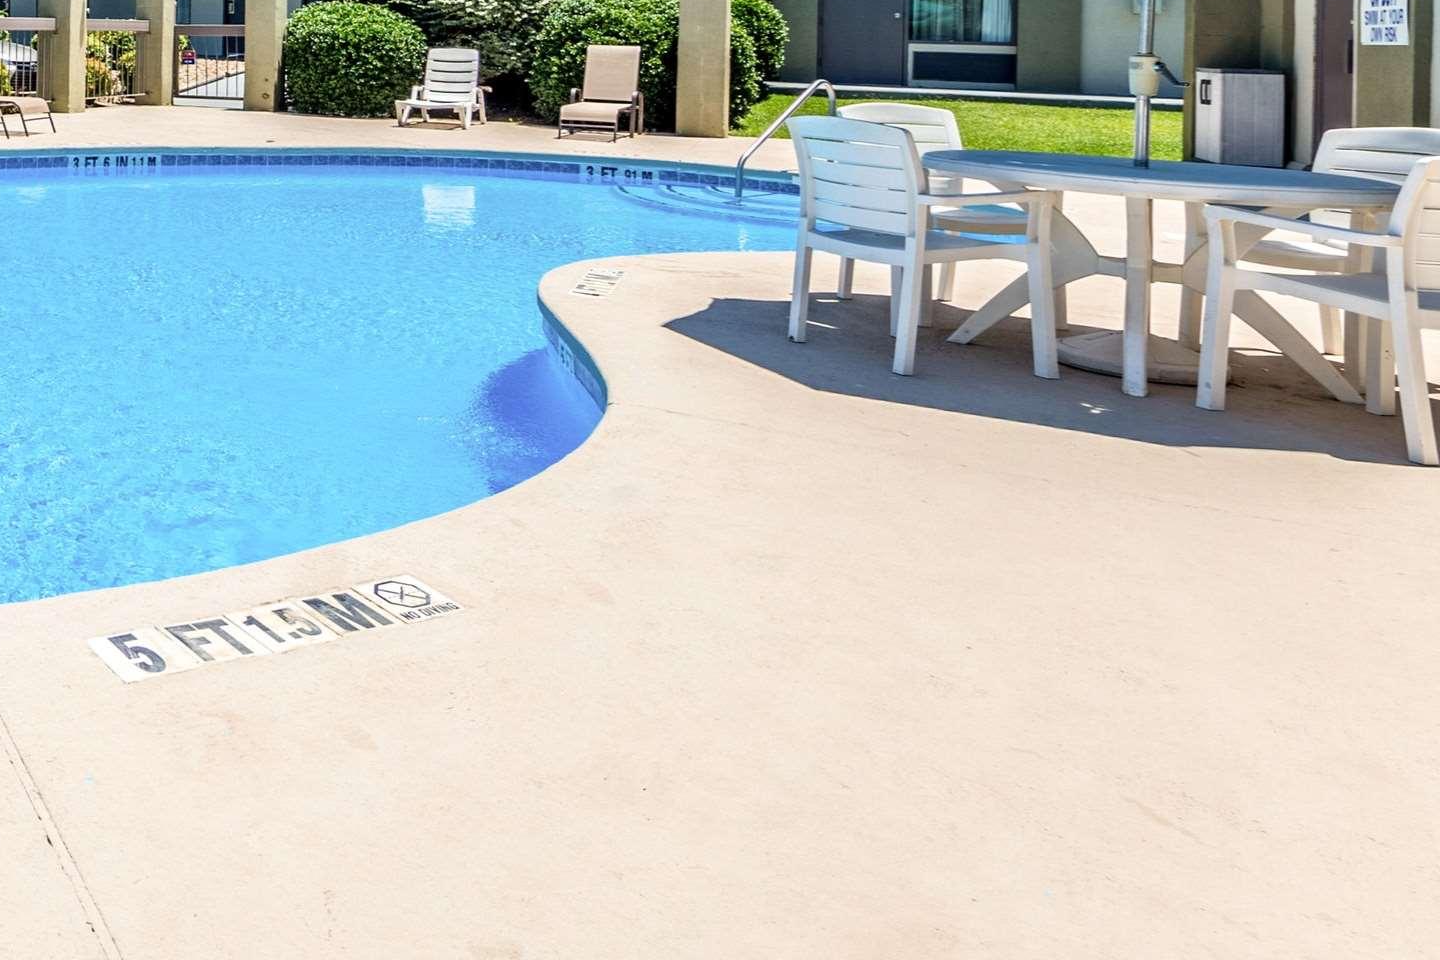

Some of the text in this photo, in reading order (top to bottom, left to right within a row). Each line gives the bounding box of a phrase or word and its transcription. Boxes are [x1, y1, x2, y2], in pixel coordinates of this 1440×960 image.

[1364, 8, 1403, 26] SWIM AT YOUR
[1370, 26, 1398, 42] OWN RISK
[73, 157, 80, 168] 3
[84, 156, 98, 168] FT
[116, 156, 128, 167] IN
[147, 156, 156, 167] M
[601, 167, 618, 177] FT
[642, 171, 653, 180] M
[400, 602, 459, 620] NO DIVING
[108, 592, 395, 673] 5 FT 1.5 M
